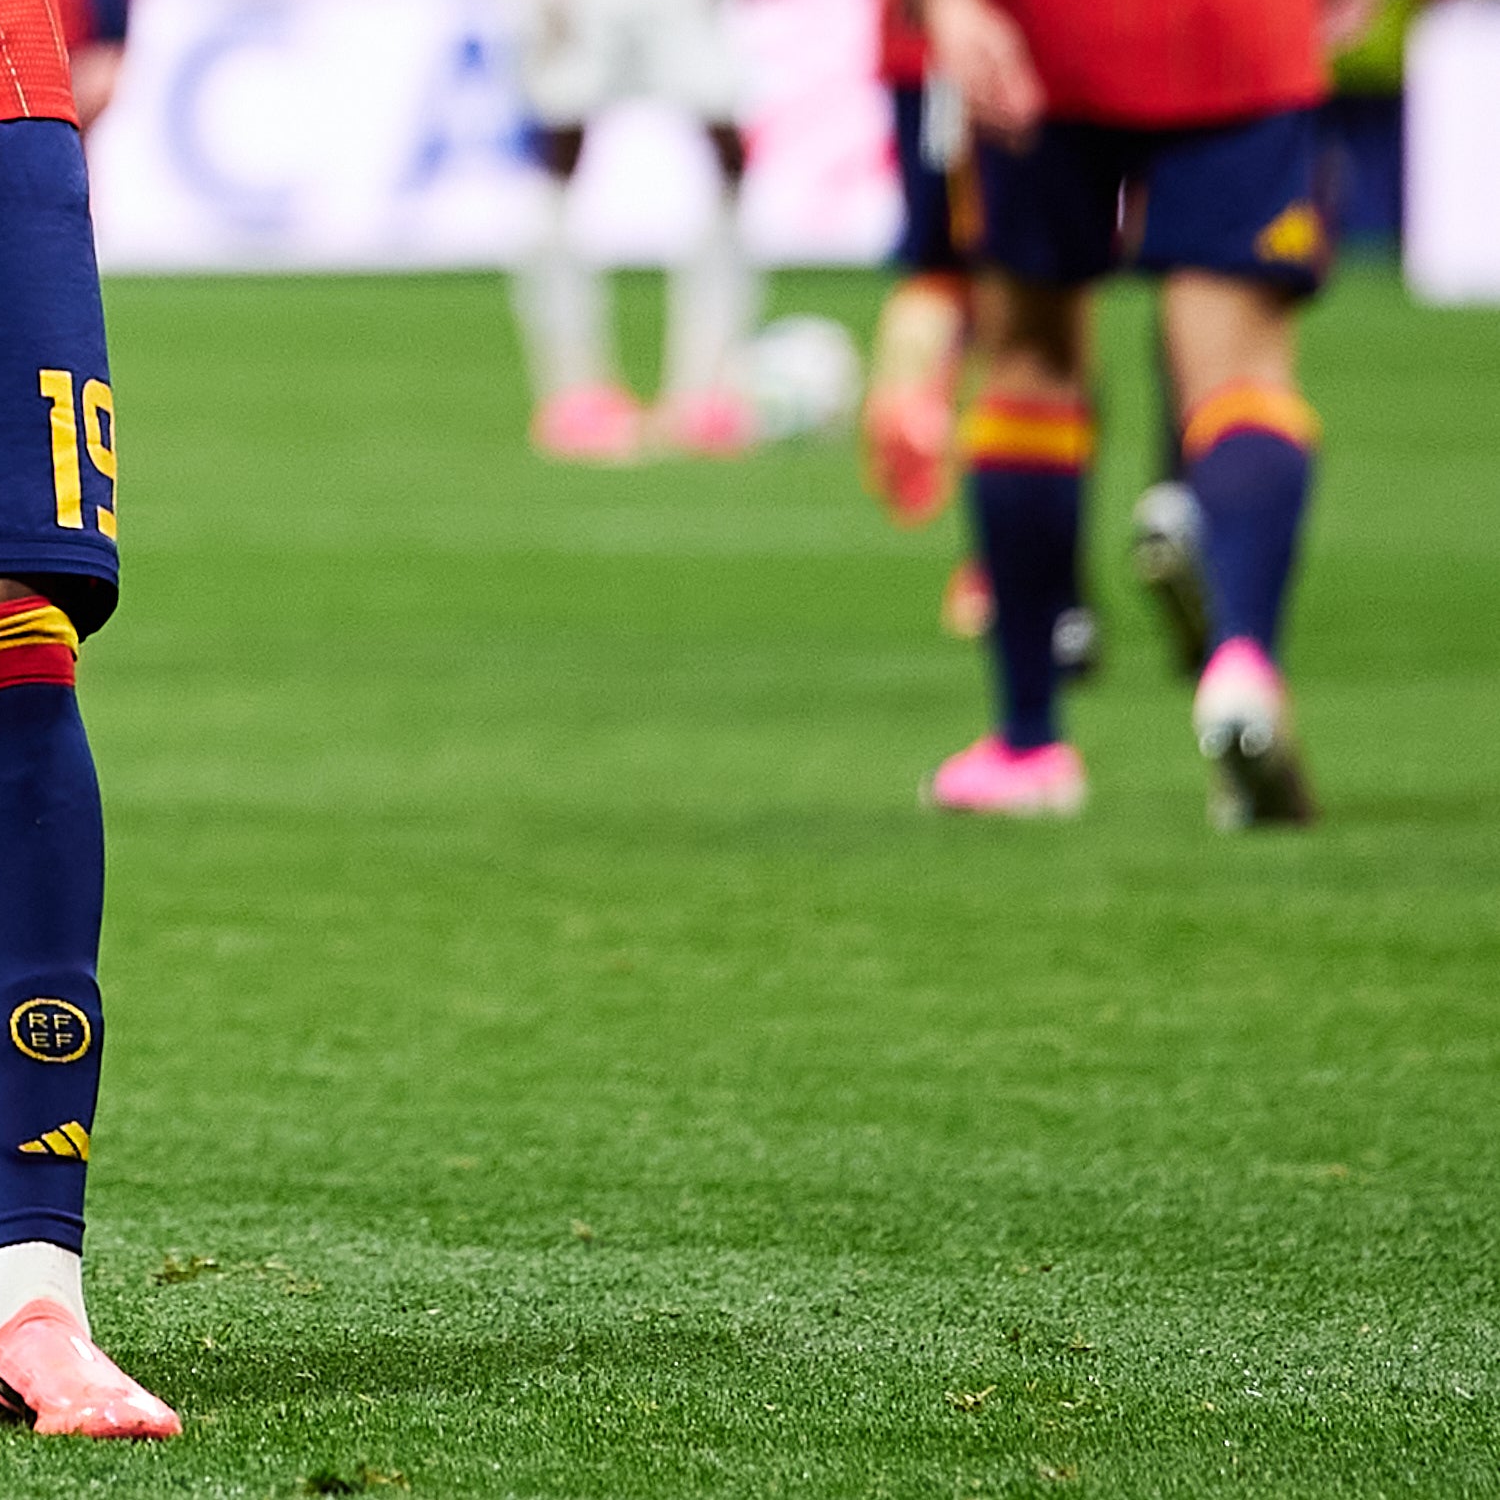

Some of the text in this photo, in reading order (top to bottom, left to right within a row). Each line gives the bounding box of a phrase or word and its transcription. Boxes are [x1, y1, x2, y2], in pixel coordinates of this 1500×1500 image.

[39, 369, 117, 541] 19
[28, 1012, 72, 1030] RF
[31, 1032, 73, 1048] EF
